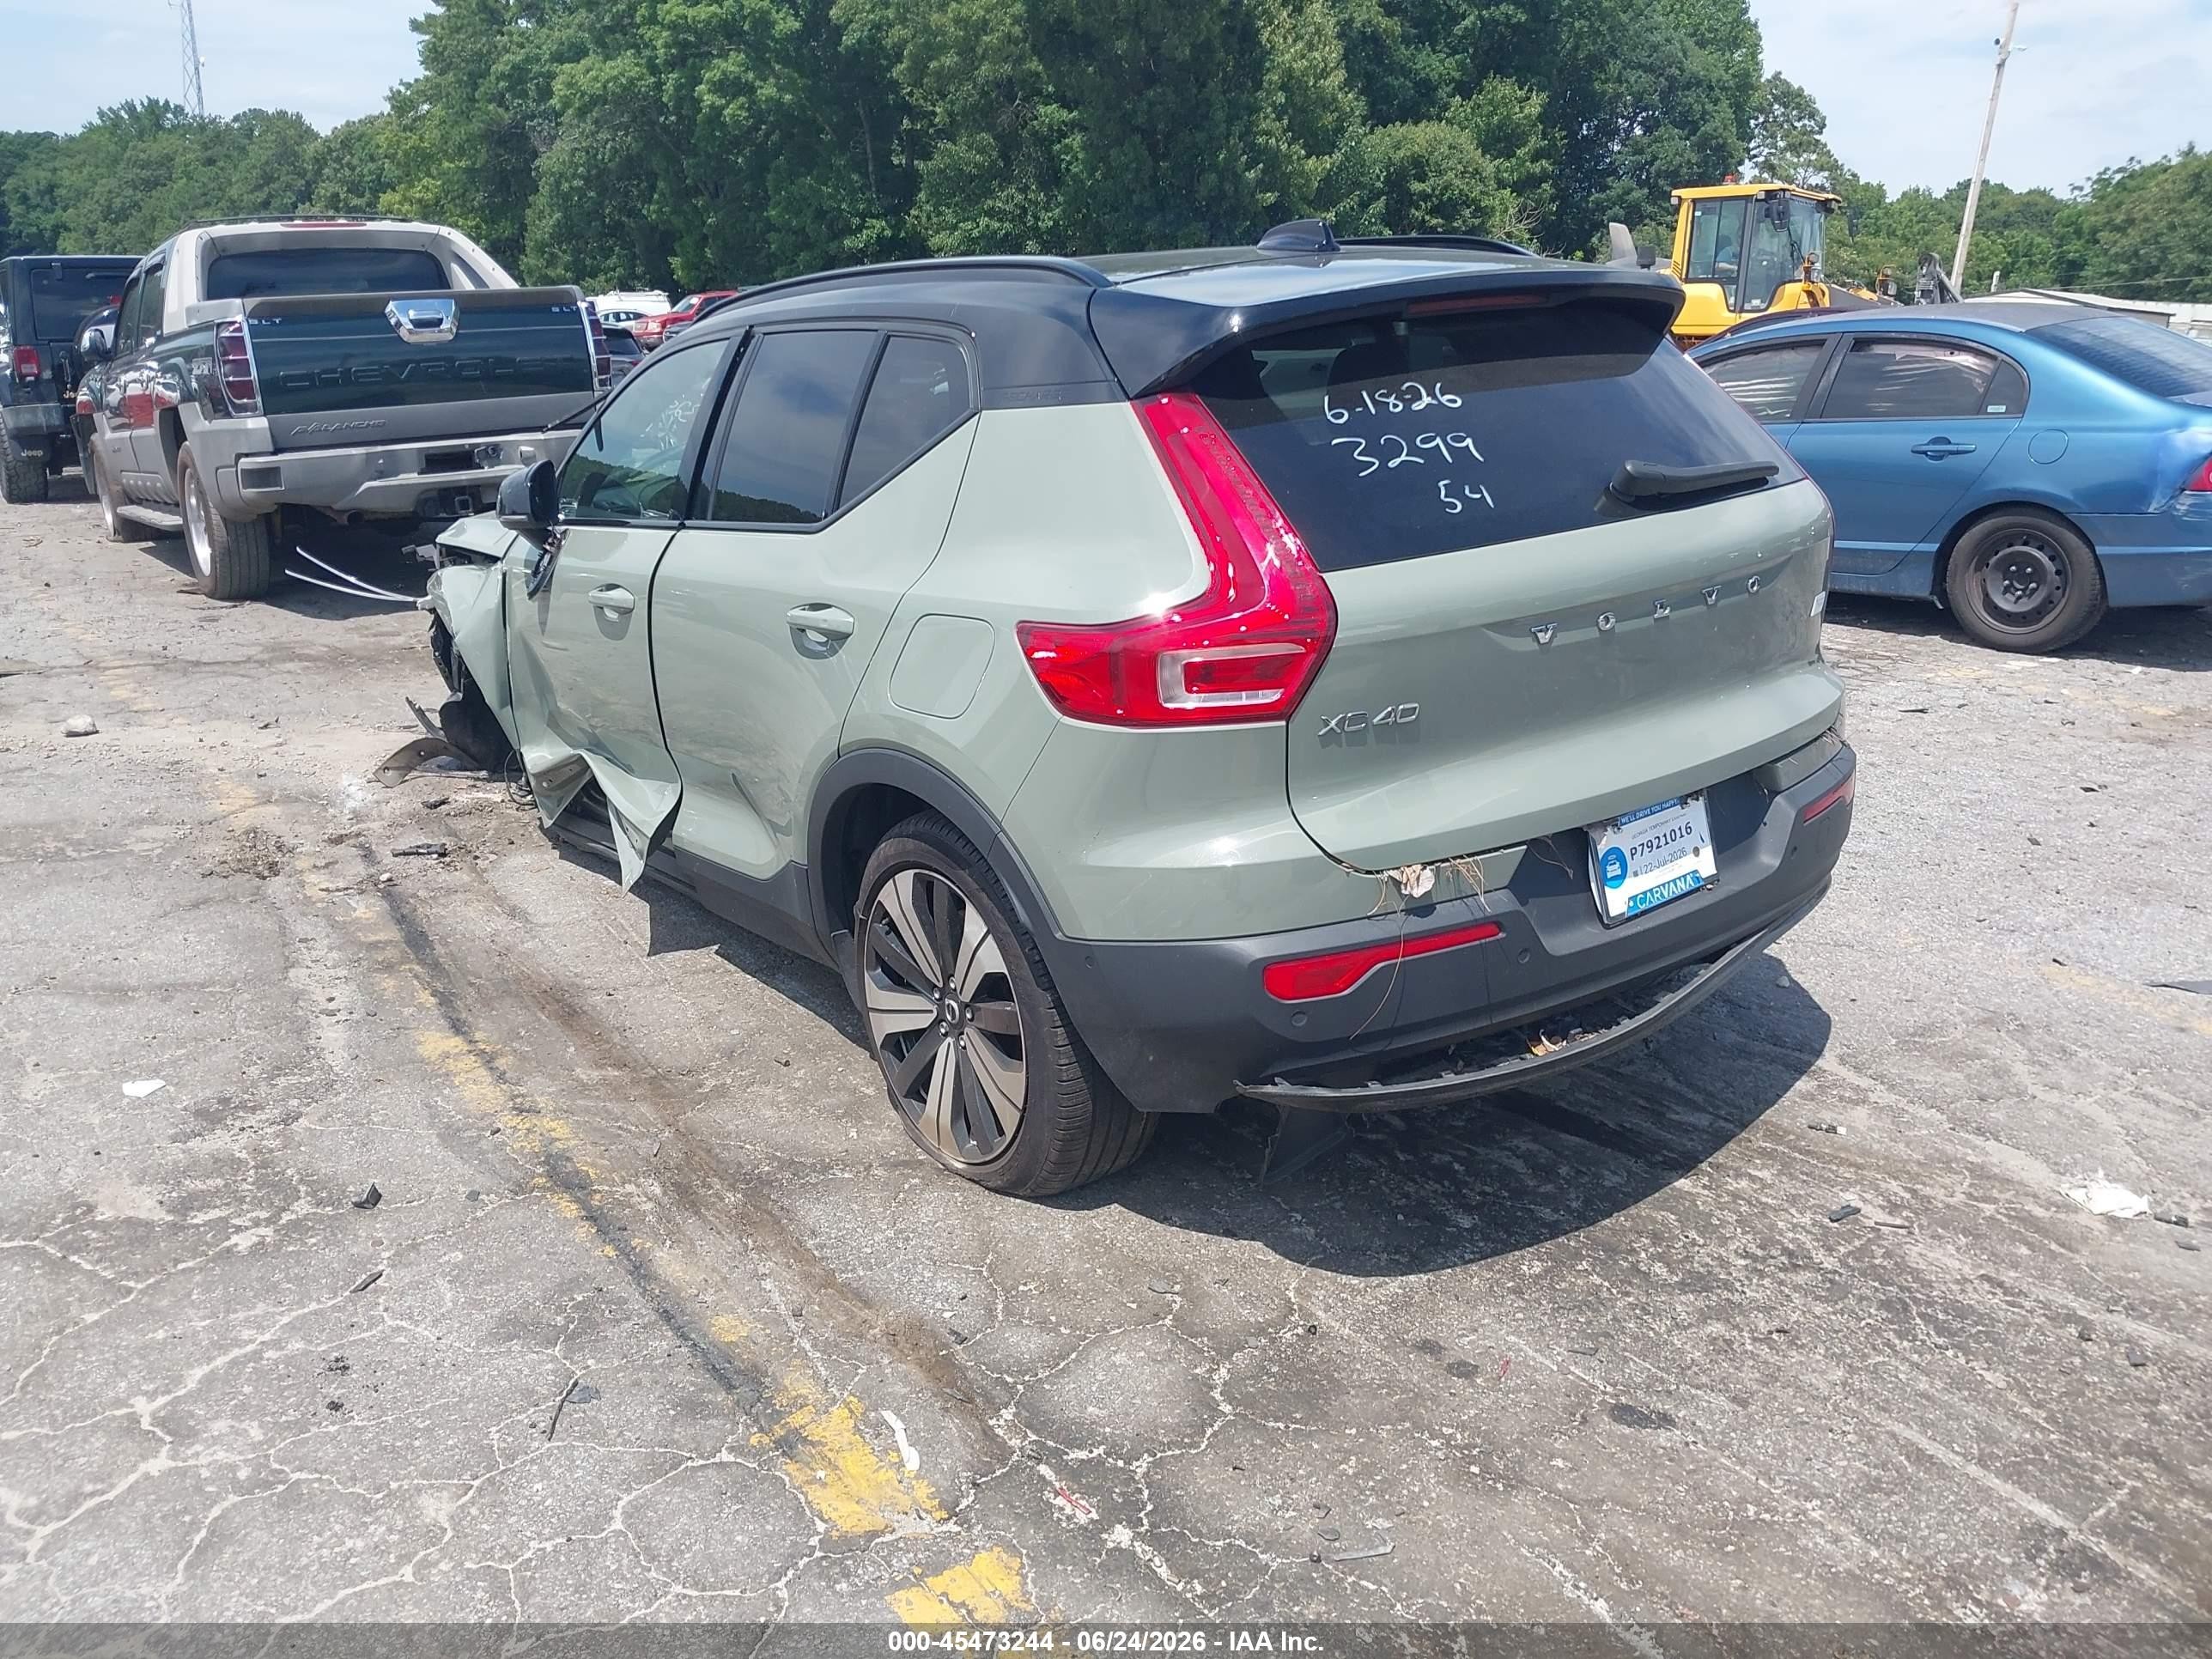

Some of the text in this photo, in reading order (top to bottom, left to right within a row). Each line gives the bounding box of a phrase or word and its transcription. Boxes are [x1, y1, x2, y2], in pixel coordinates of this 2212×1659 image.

[290, 419, 386, 435] AVALANCHE
[1331, 432, 1485, 477] 3299
[1437, 479, 1495, 514] 54
[1529, 574, 1761, 645] VOLVO
[1317, 702, 1419, 736] XC40
[1636, 810, 1651, 819] DRIVE
[1651, 805, 1662, 813] YOU
[1630, 821, 1692, 860] P7921016
[1637, 874, 1695, 908] CARVANA
